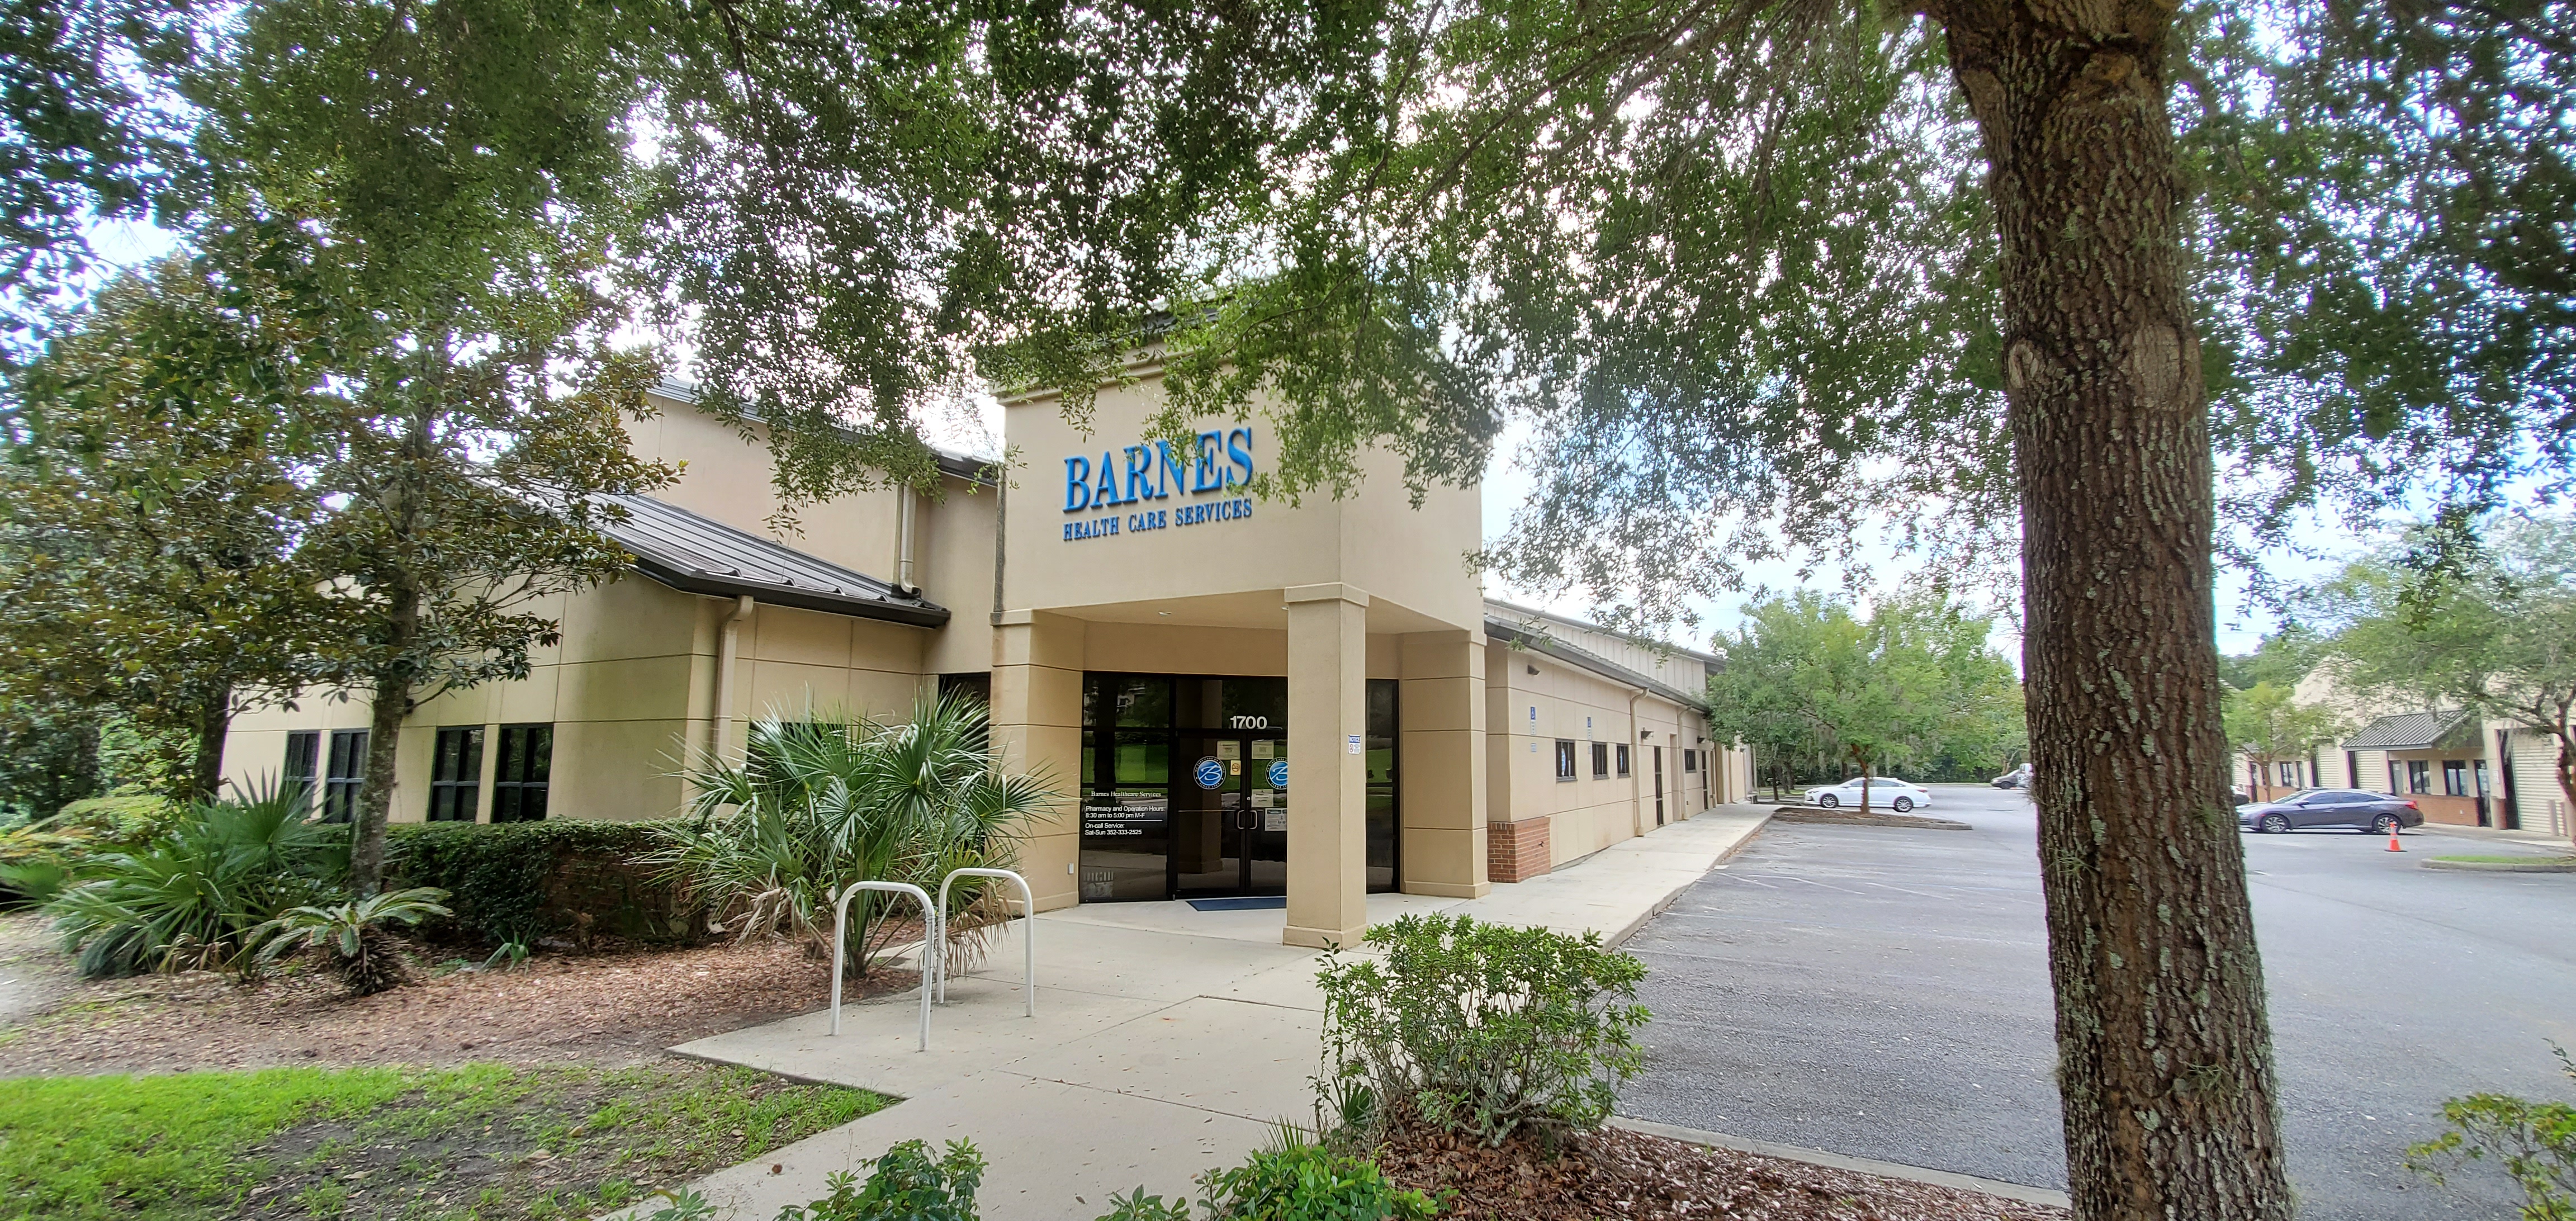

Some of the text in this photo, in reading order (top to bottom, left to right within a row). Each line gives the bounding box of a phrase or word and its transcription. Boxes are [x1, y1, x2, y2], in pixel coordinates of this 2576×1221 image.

[1062, 427, 1253, 513] BARNES
[1063, 498, 1252, 541] HEALTH CARE SERVICES
[1230, 716, 1267, 730] 1700
